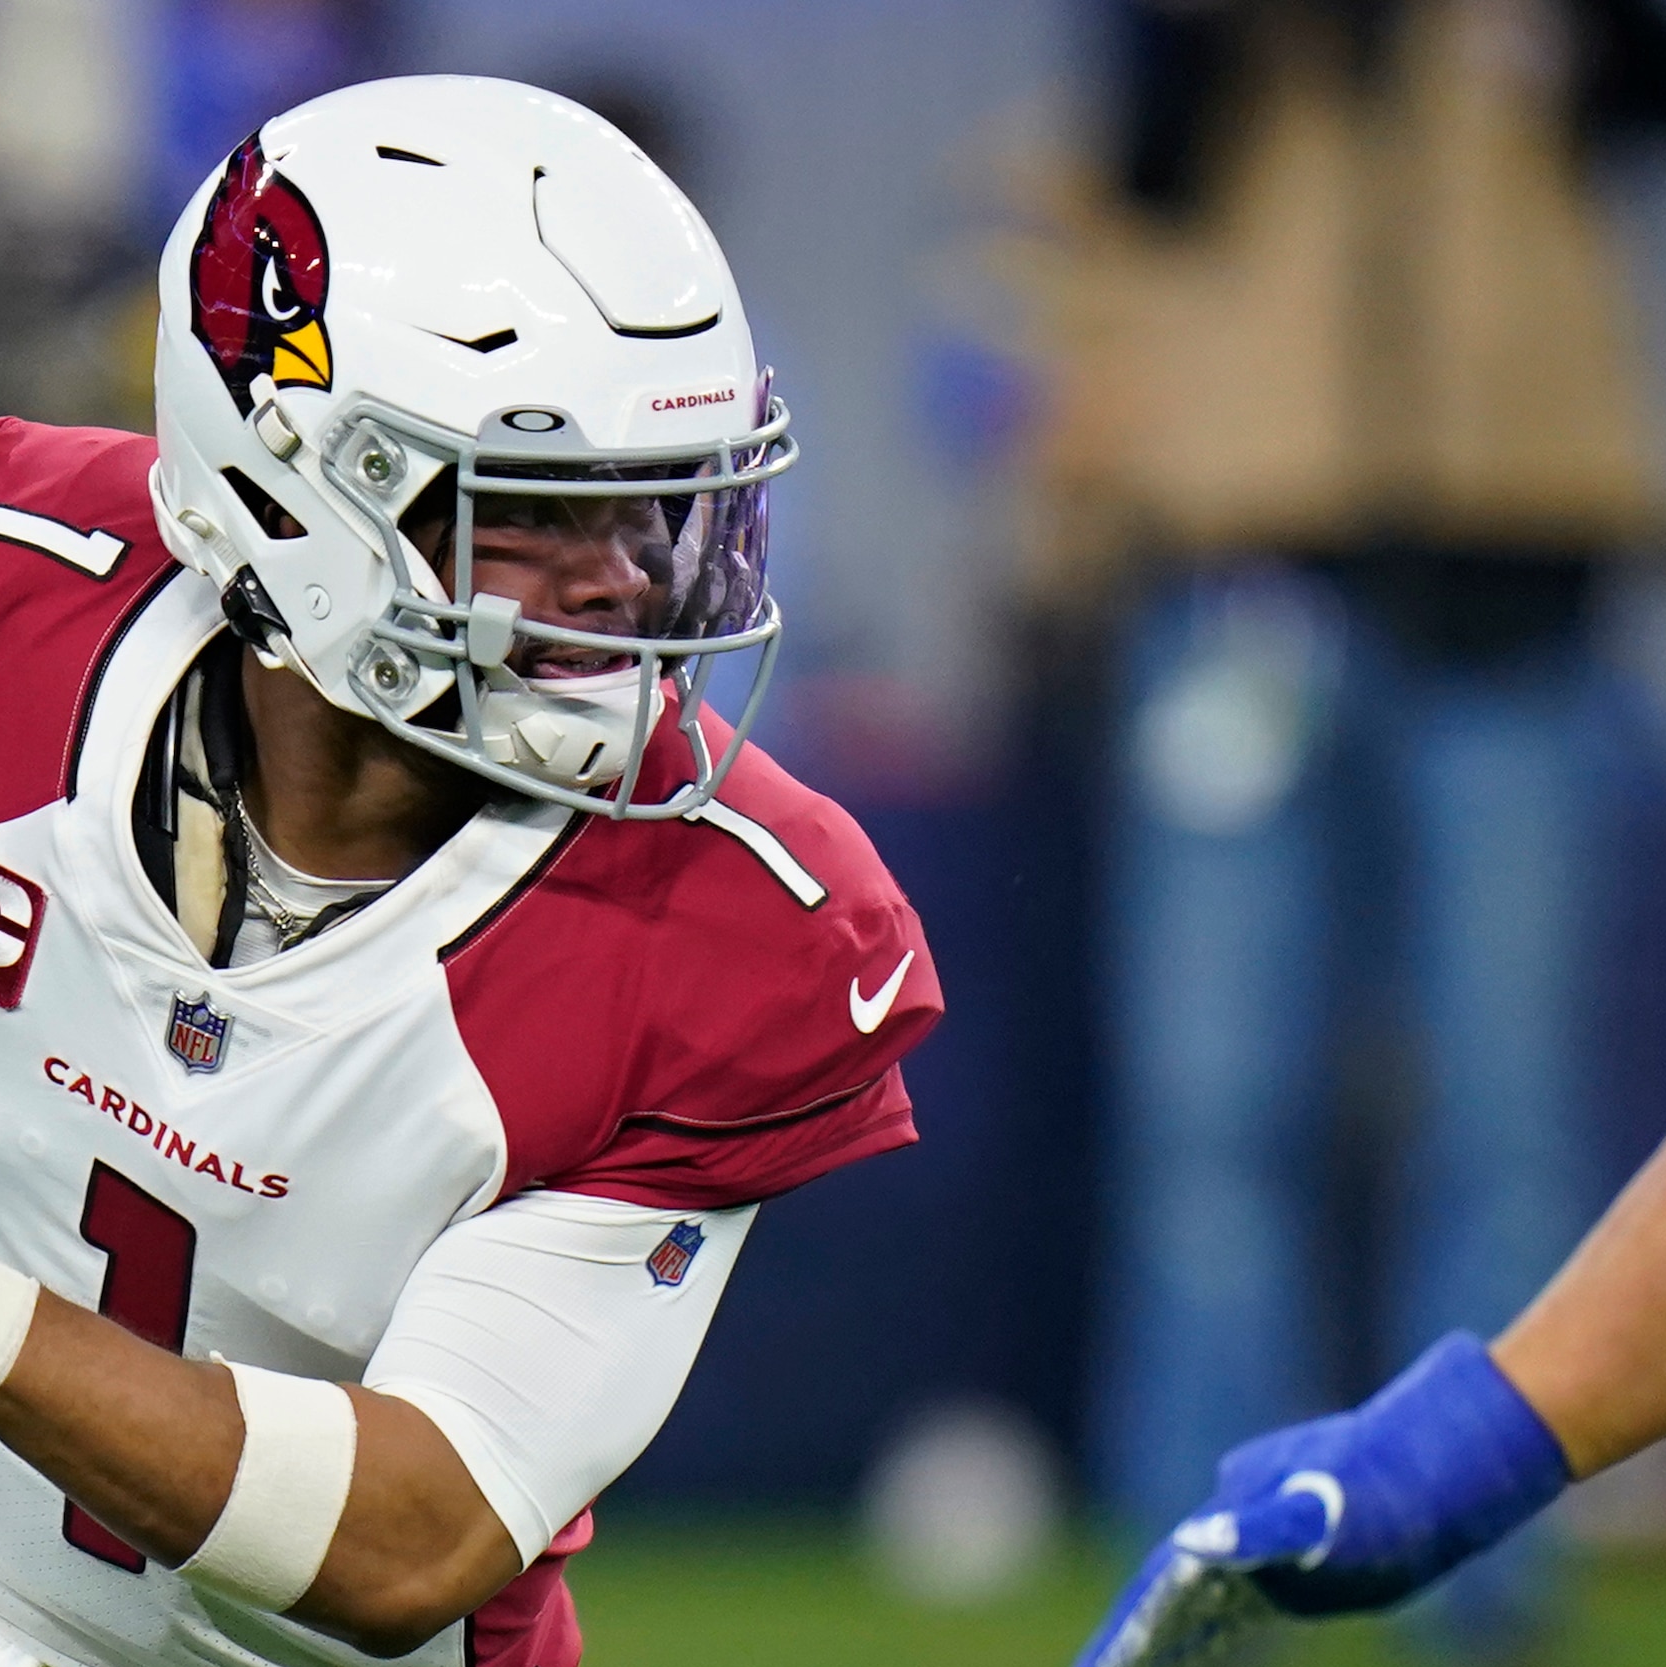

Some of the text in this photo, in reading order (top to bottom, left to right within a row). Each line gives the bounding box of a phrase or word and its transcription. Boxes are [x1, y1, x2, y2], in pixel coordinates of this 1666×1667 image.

[652, 389, 735, 411] CARDINALS
[678, 780, 829, 912] 1
[173, 1022, 215, 1062] NFL
[44, 1056, 290, 1199] CARDINALS
